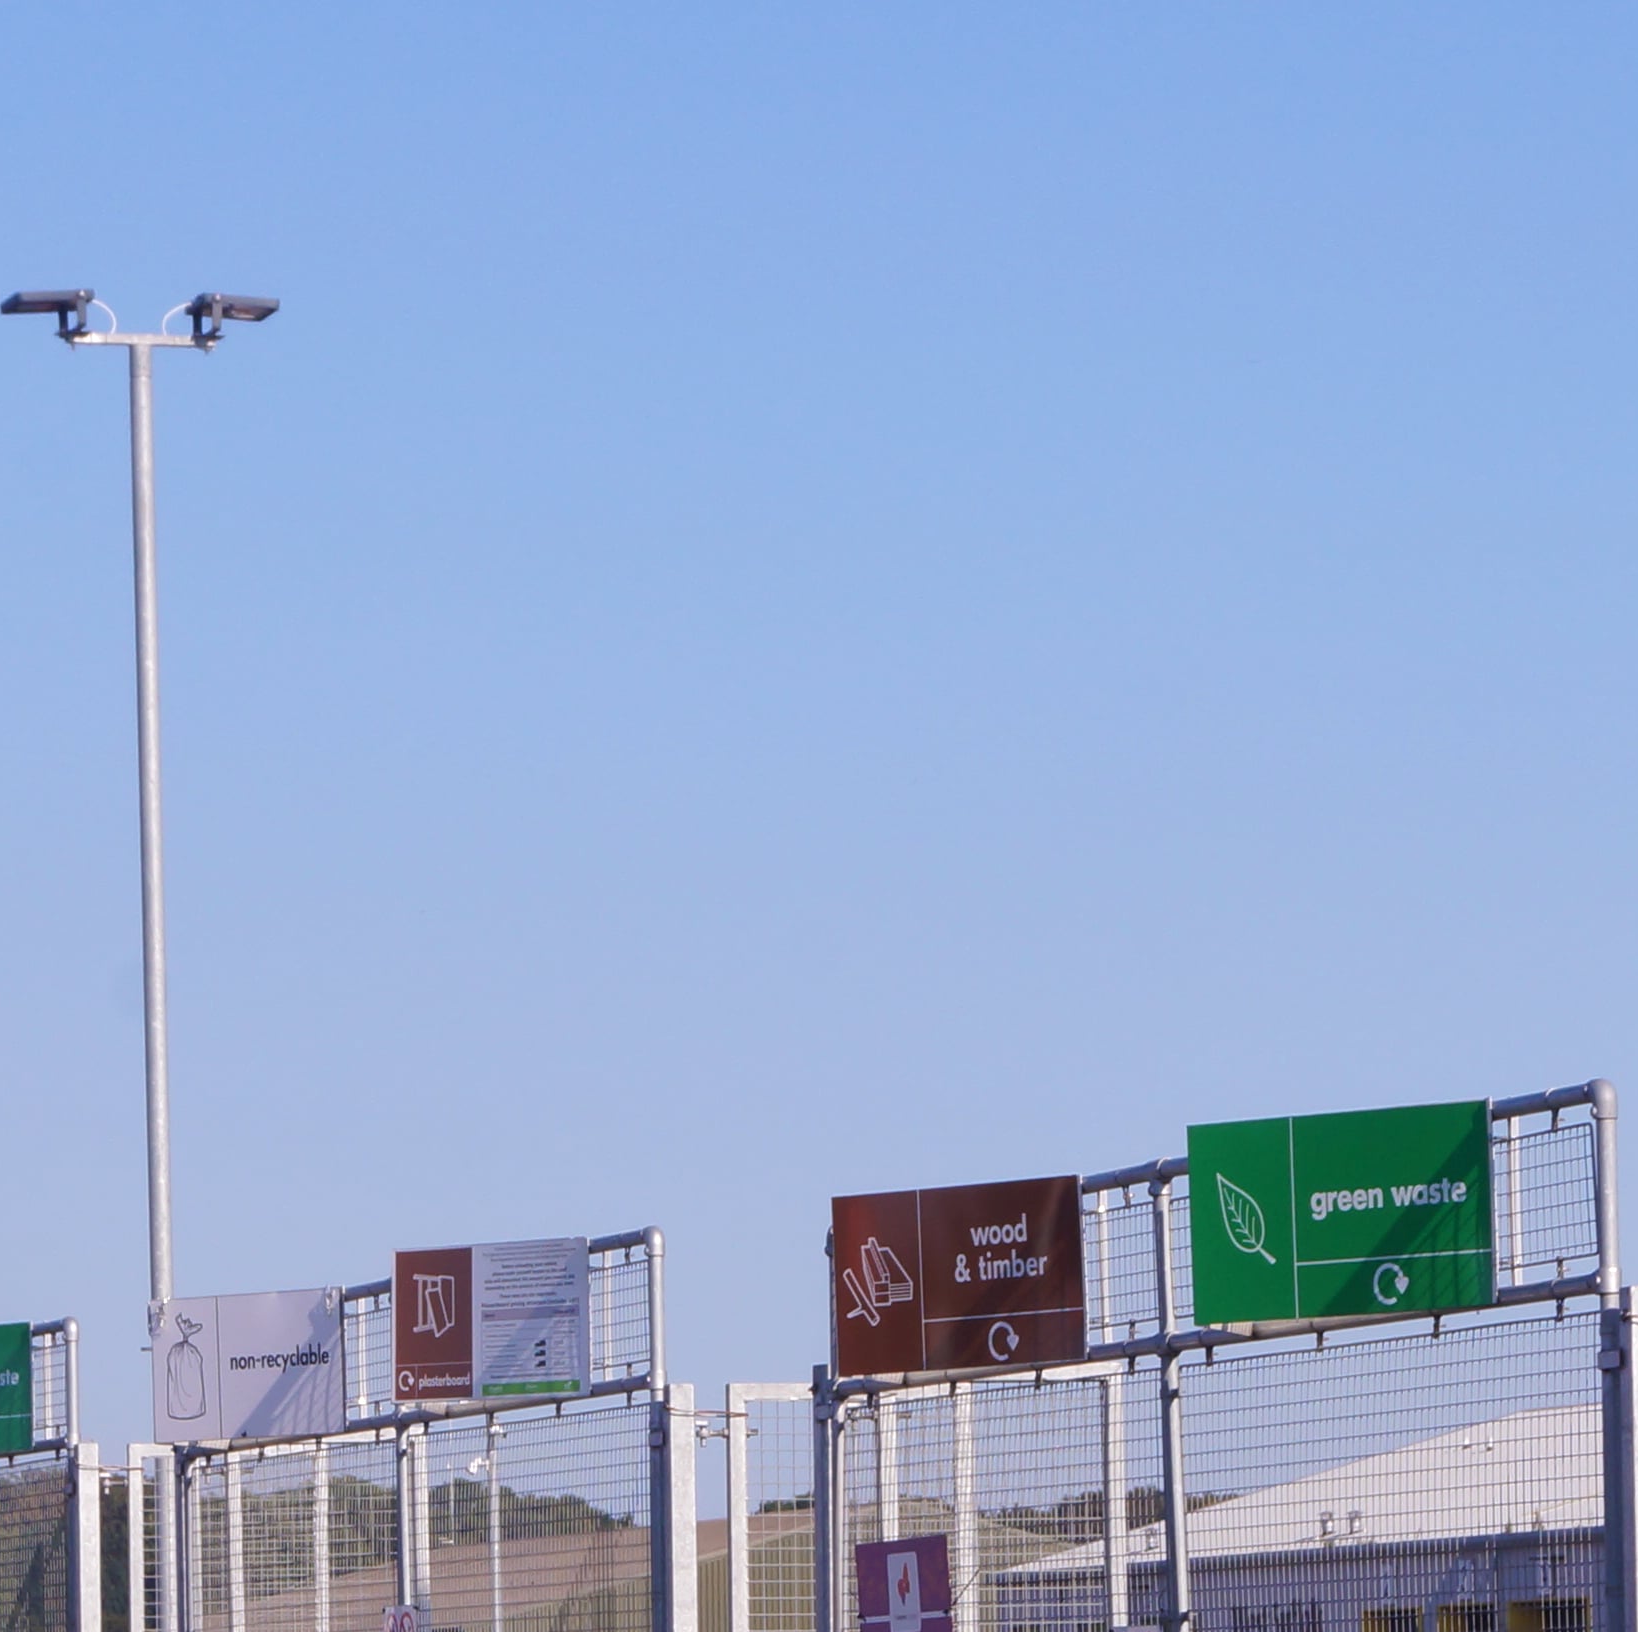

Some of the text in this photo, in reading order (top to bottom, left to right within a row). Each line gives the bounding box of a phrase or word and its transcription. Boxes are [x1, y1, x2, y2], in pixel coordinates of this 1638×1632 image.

[1310, 1177, 1467, 1221] green waste
[970, 1212, 1027, 1247] wood
[954, 1248, 1048, 1283] & timber
[229, 1343, 330, 1373] non-recyclable
[418, 1366, 471, 1391] plasterboard
